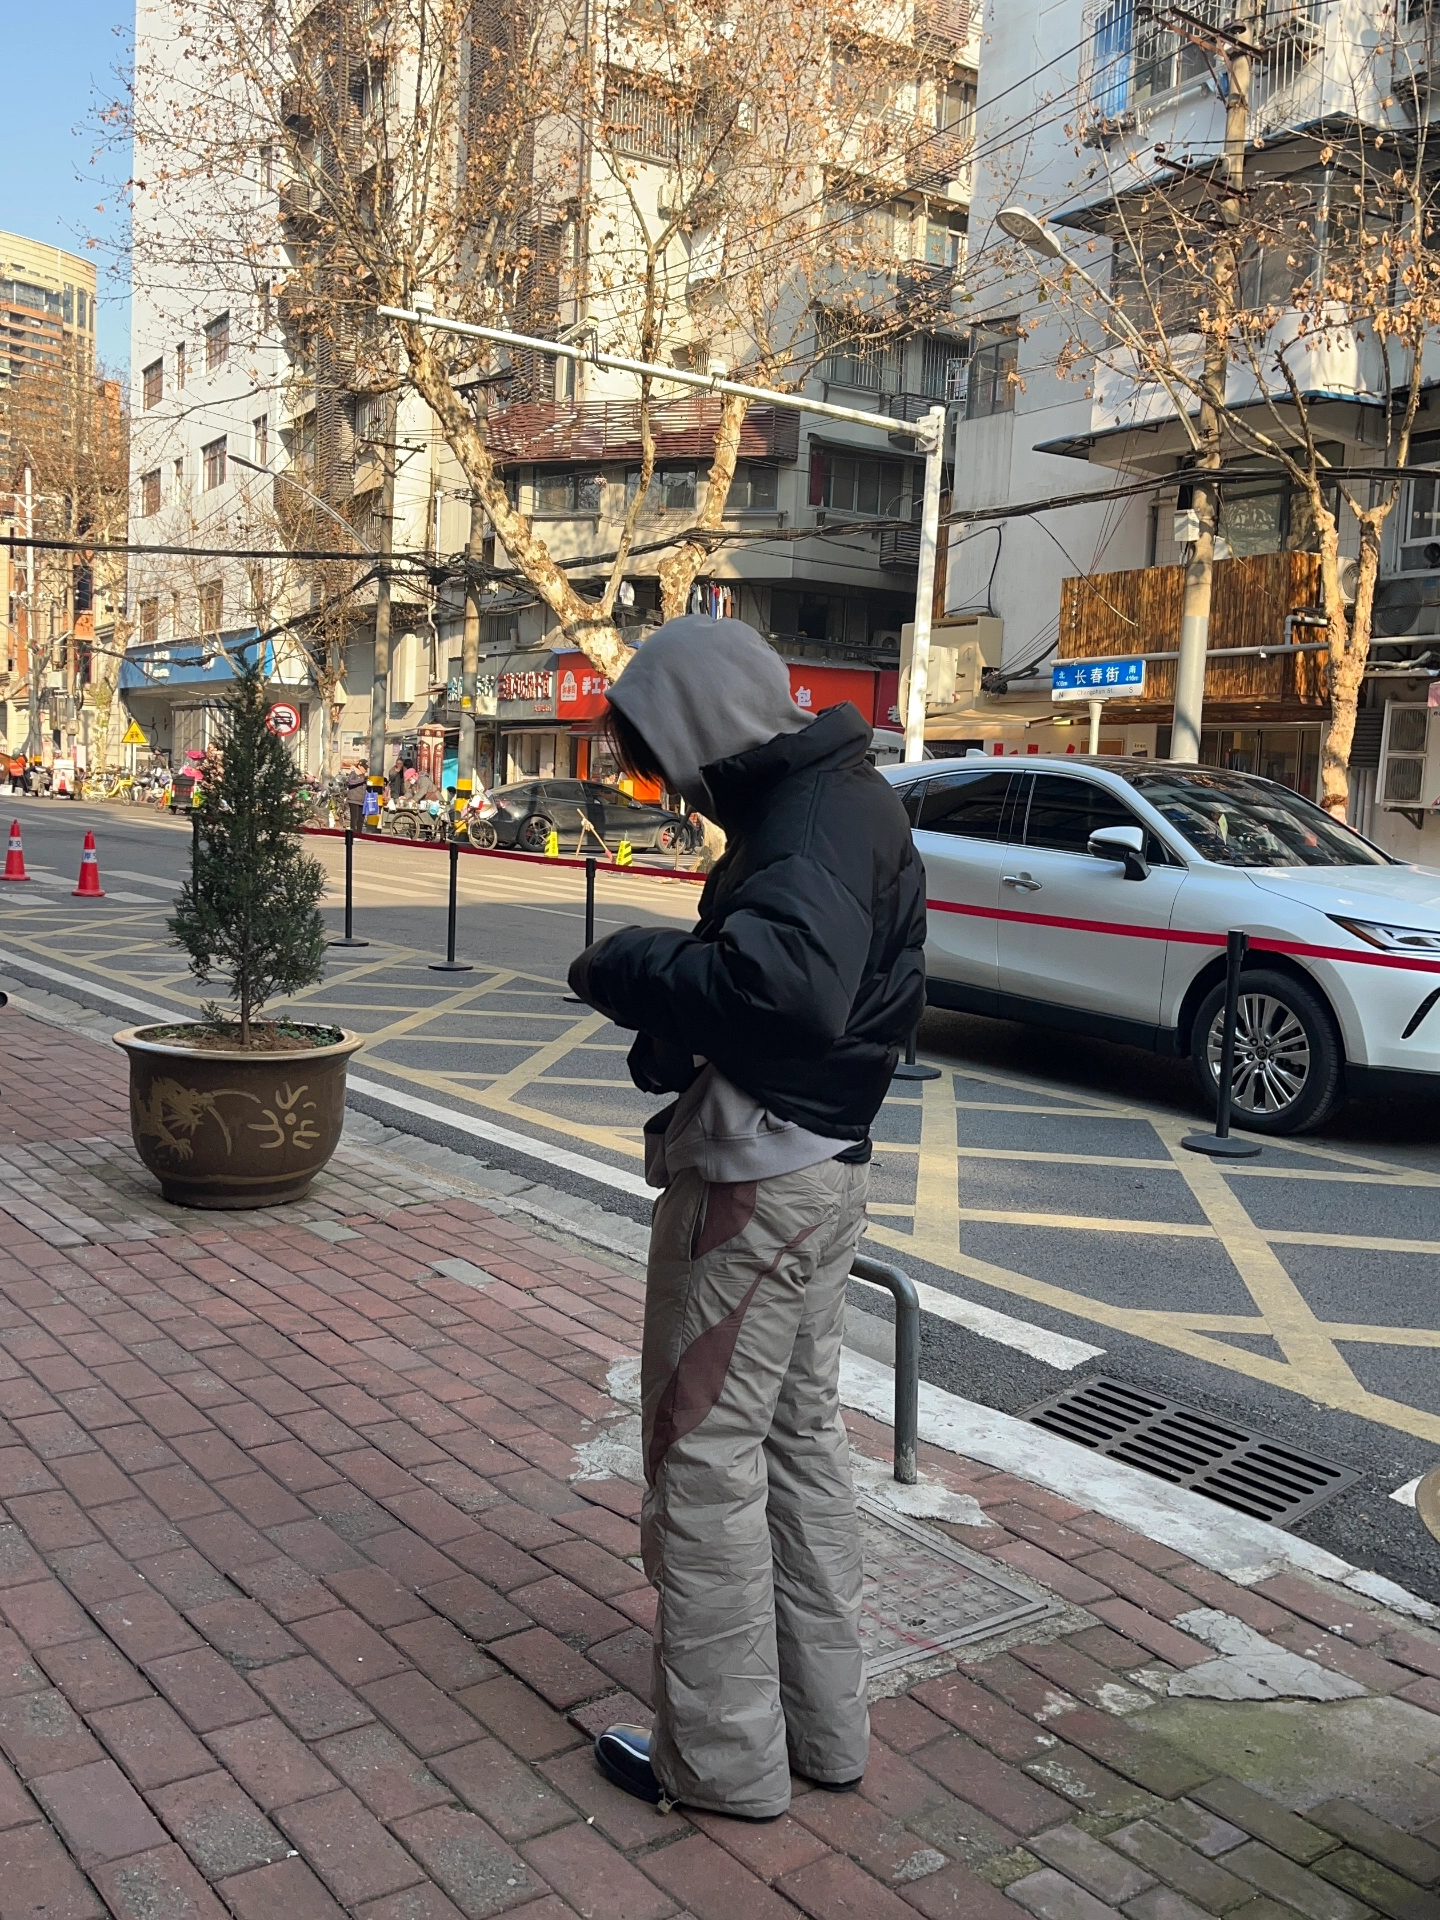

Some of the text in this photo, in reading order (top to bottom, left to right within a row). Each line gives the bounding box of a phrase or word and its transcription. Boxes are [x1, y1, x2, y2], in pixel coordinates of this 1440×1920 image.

[1059, 671, 1065, 679] 北
[1075, 667, 1119, 685] 长春街
[795, 686, 811, 706] 包
